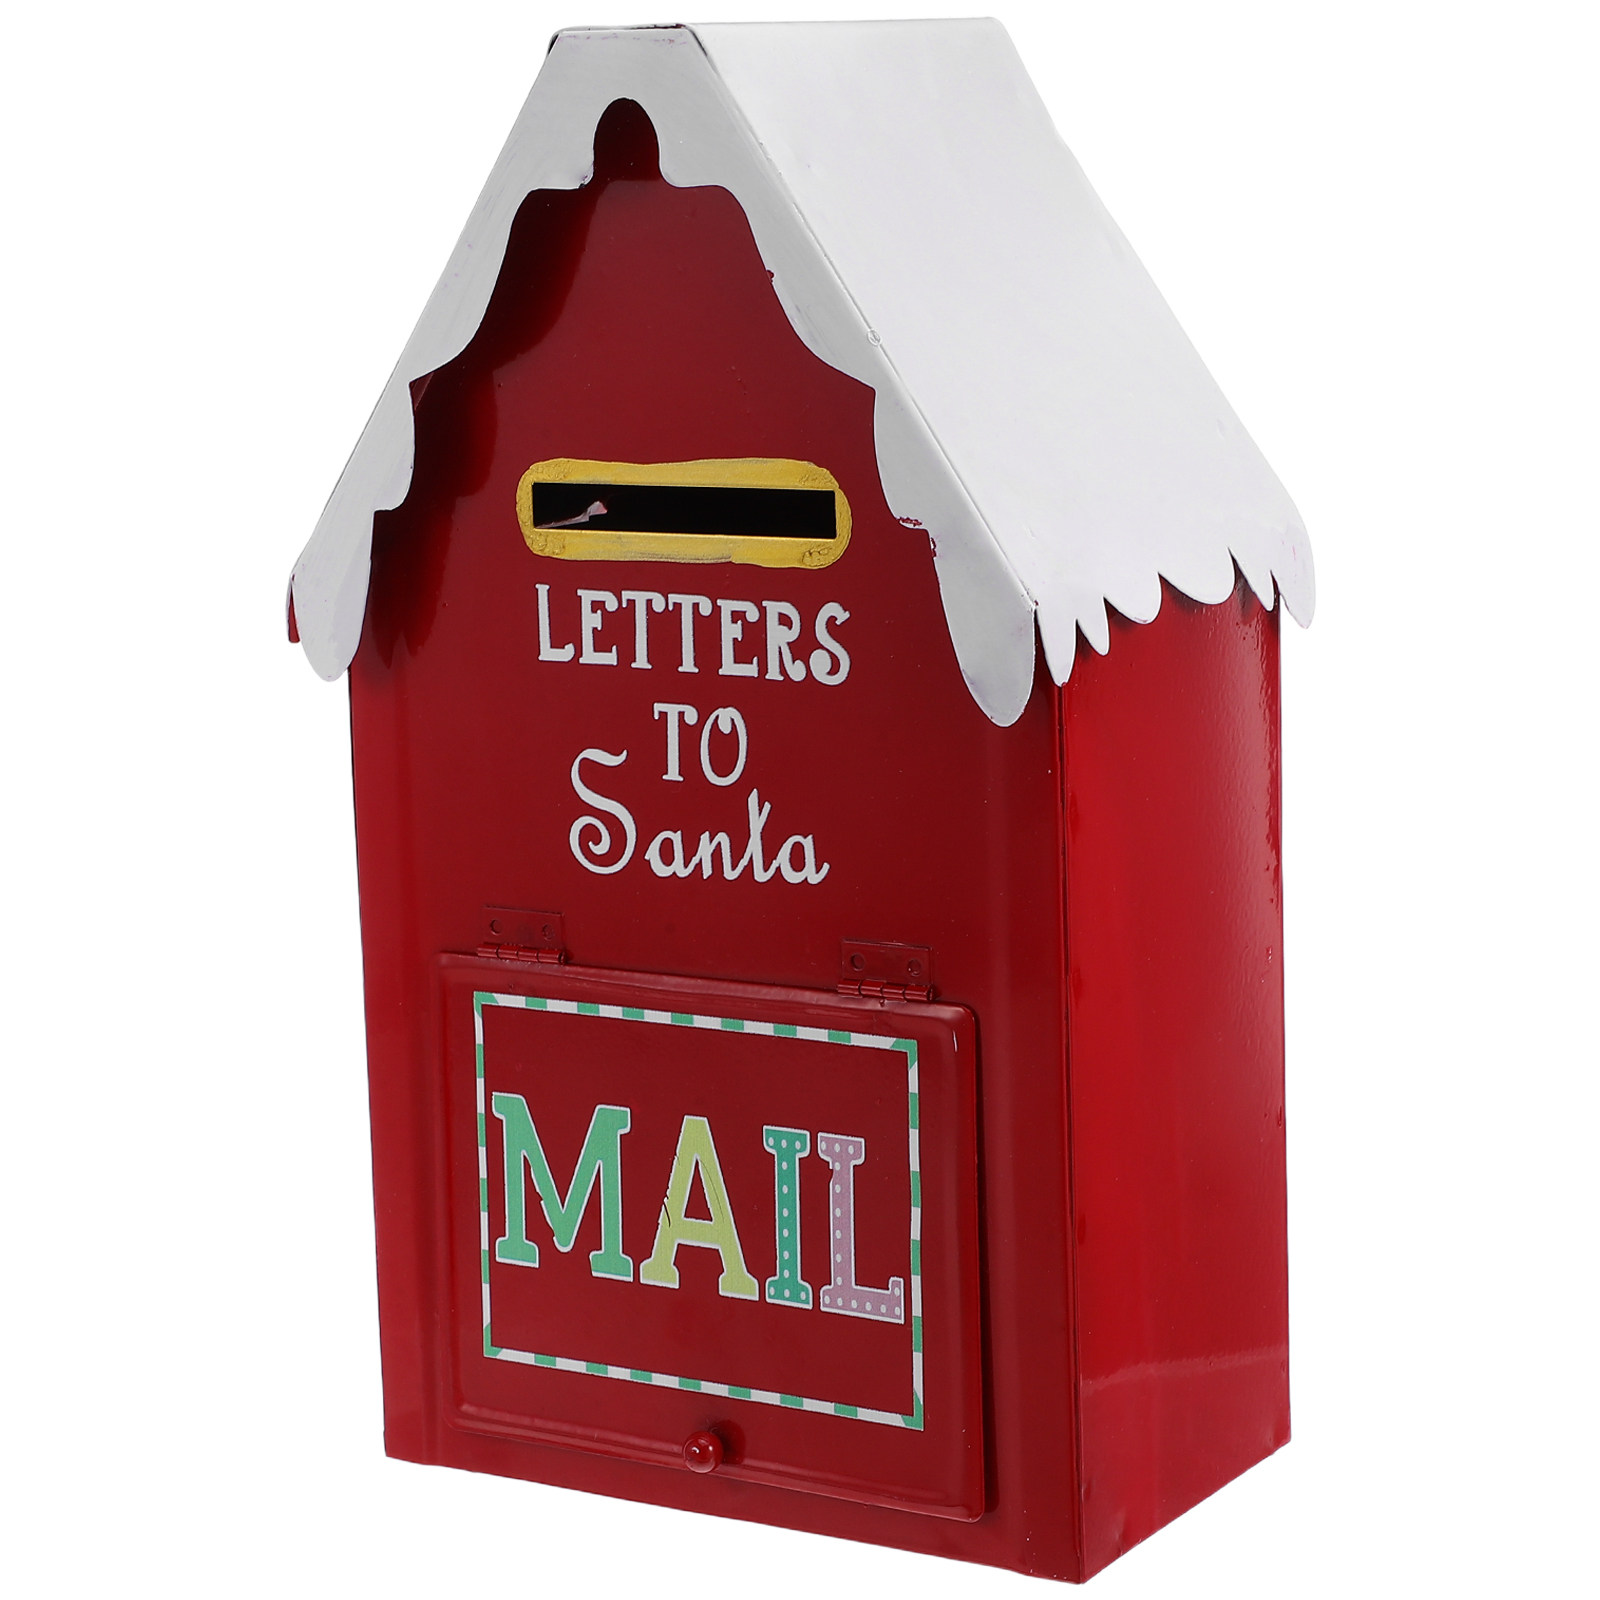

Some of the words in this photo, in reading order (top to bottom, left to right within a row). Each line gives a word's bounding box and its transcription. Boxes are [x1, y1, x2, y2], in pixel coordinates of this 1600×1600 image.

[536, 584, 850, 685] LETTERS
[654, 703, 747, 786] TO
[570, 749, 829, 884] Santa
[491, 1092, 905, 1324] MAIL
